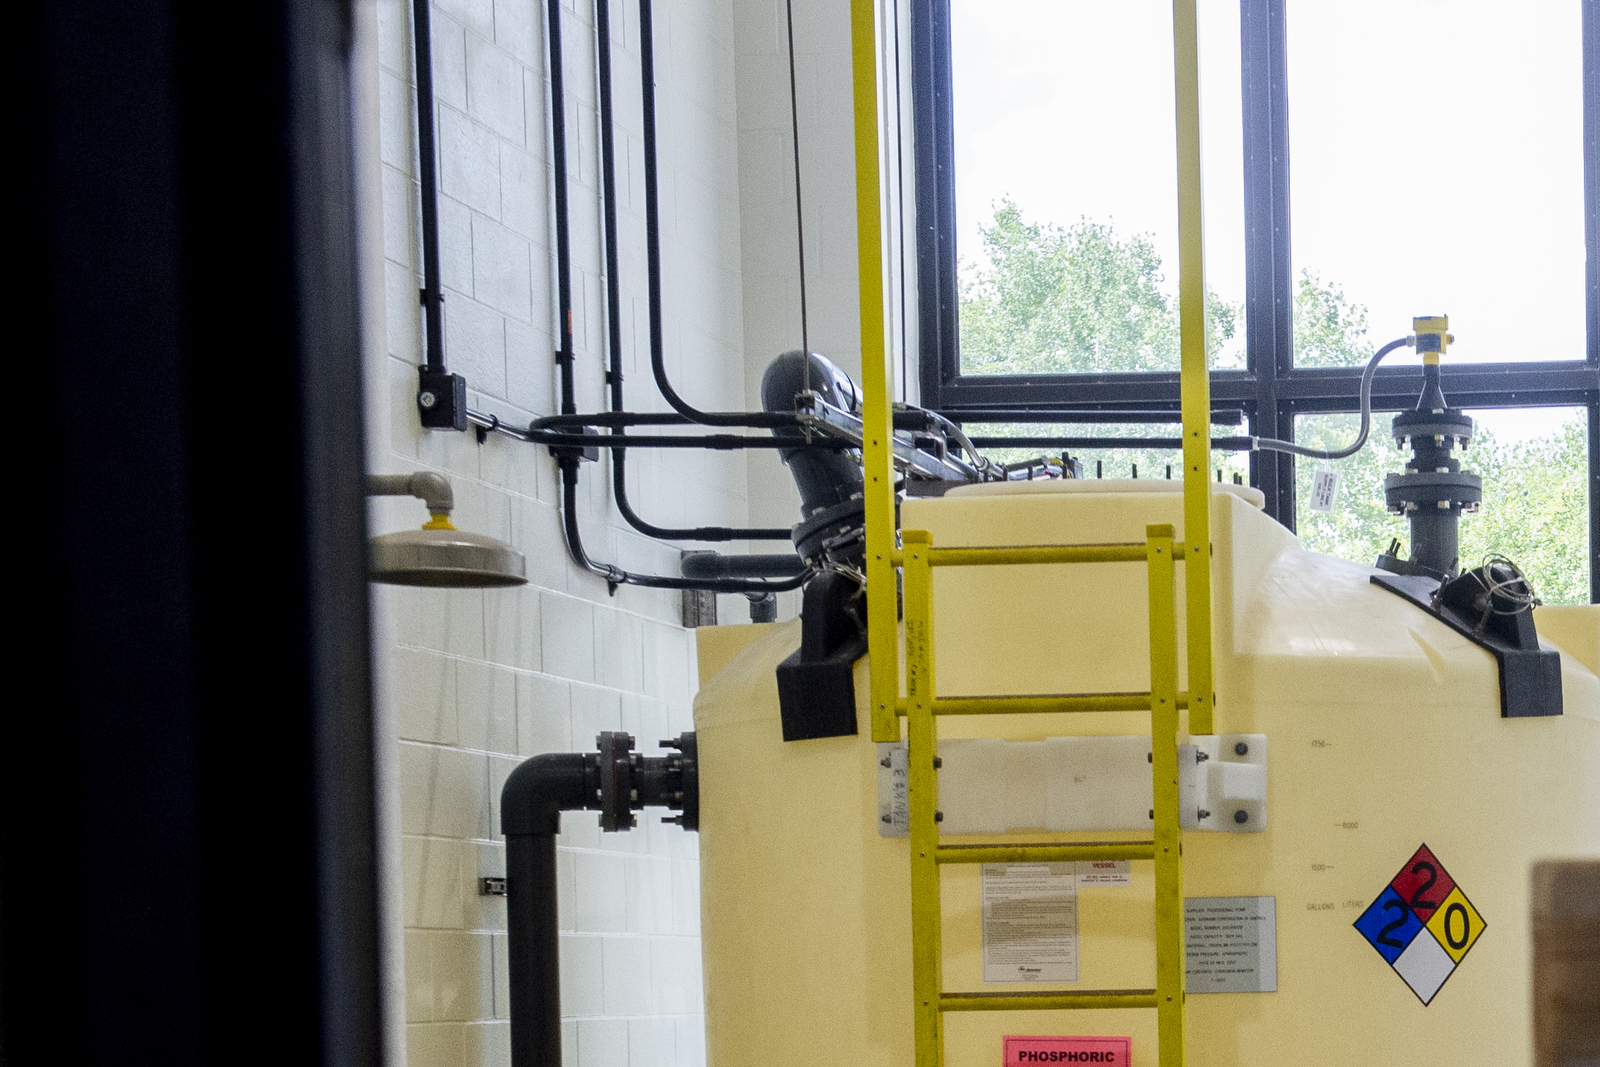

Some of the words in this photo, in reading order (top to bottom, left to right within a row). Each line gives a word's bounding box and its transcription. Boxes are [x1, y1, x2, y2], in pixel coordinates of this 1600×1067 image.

[1410, 861, 1437, 909] 2
[1306, 902, 1335, 911] GALLONS
[1376, 899, 1409, 949] 2
[1444, 902, 1470, 950] 0
[1018, 1051, 1115, 1063] PHOSPHORIC
